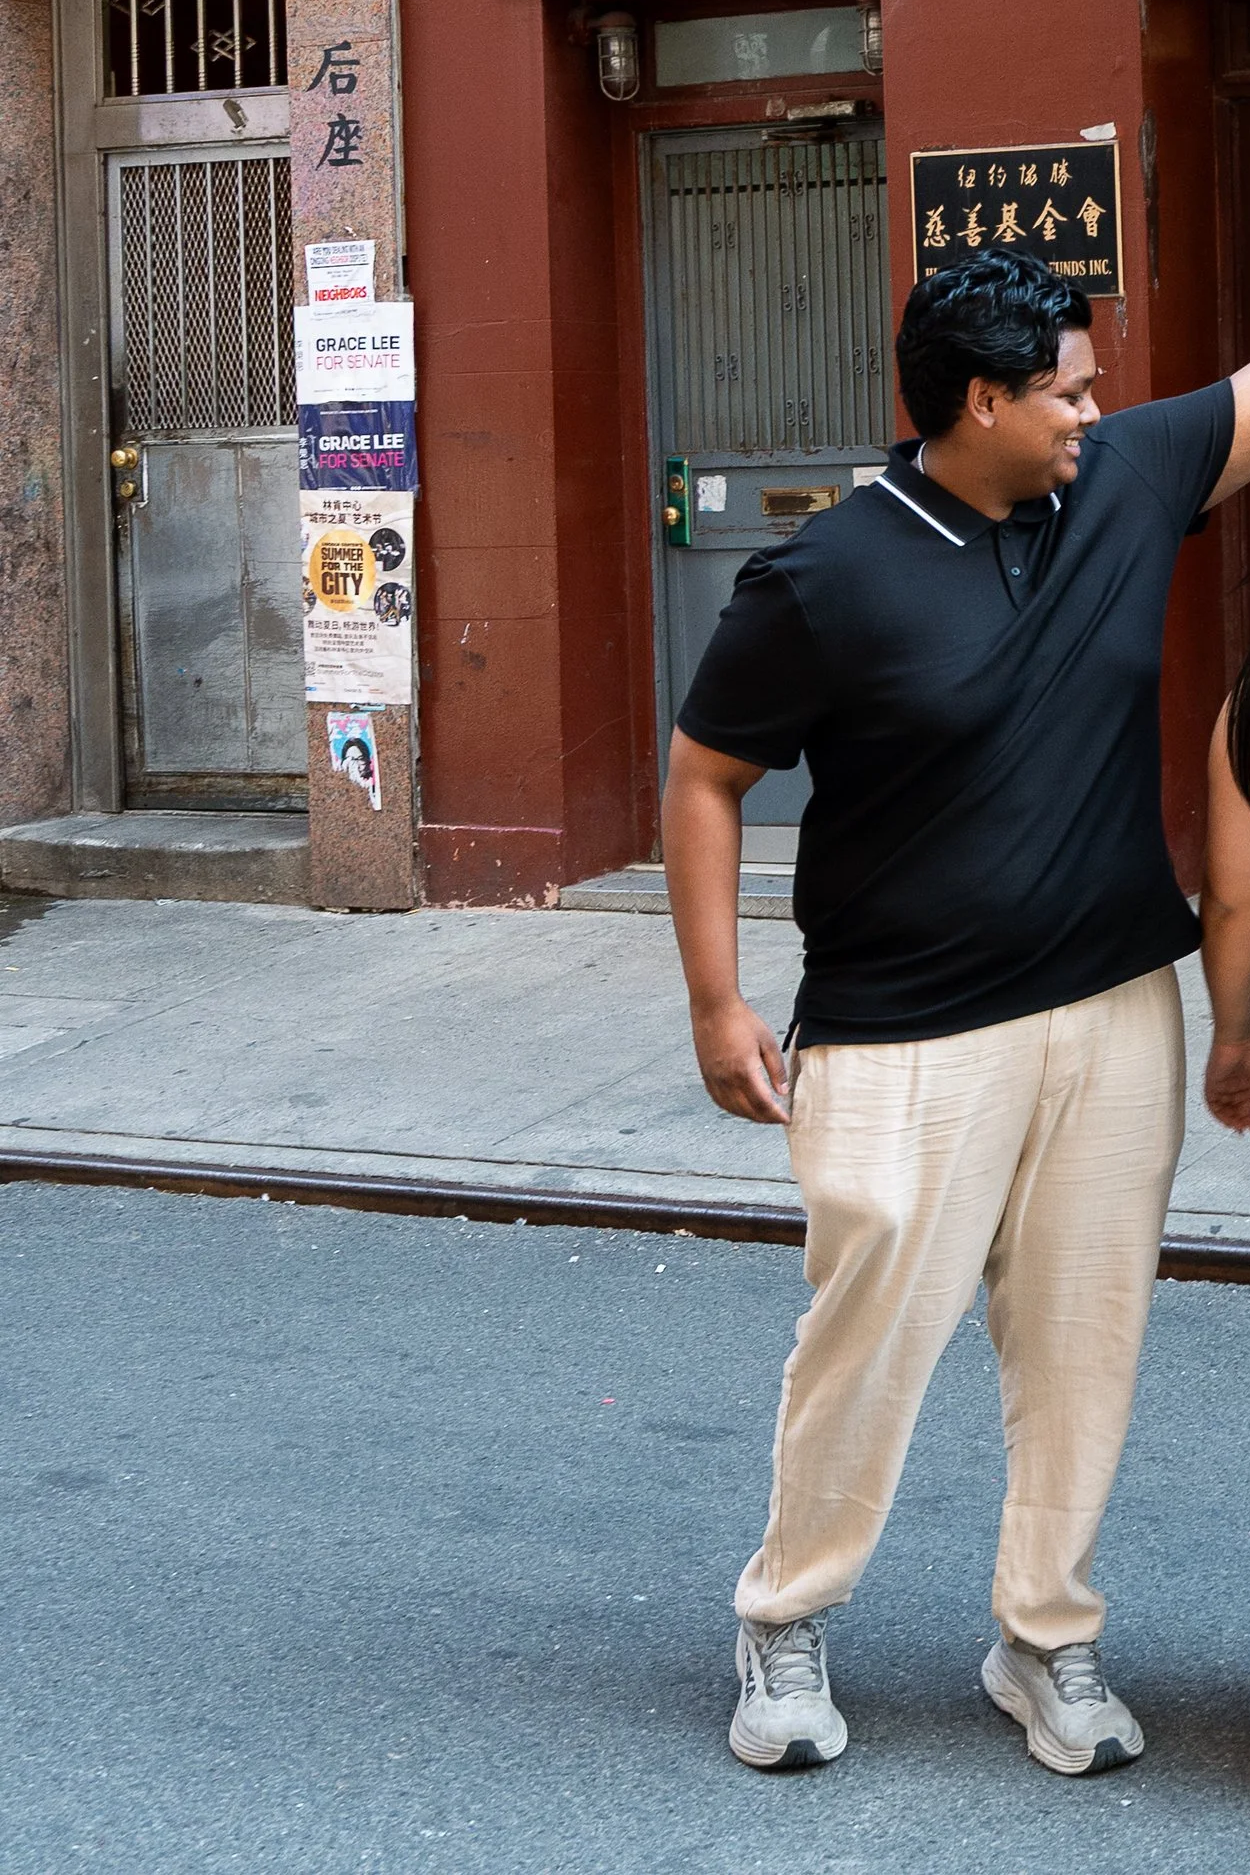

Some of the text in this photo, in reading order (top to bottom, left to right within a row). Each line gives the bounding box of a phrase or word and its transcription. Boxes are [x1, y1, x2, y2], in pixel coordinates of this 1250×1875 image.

[306, 40, 363, 171] 后座
[923, 196, 1107, 247] 慈善基金會
[1089, 259, 1112, 275] INC.
[315, 286, 367, 302] NEIGHBORS
[316, 336, 400, 352] GRACE LEE
[316, 354, 400, 370] FOR SENATE
[319, 434, 404, 451] GRACE LEE
[319, 451, 404, 468] FOR SENATE
[321, 547, 363, 561] SUMMER
[321, 562, 363, 571] FOR THE
[321, 572, 363, 595] CITY
